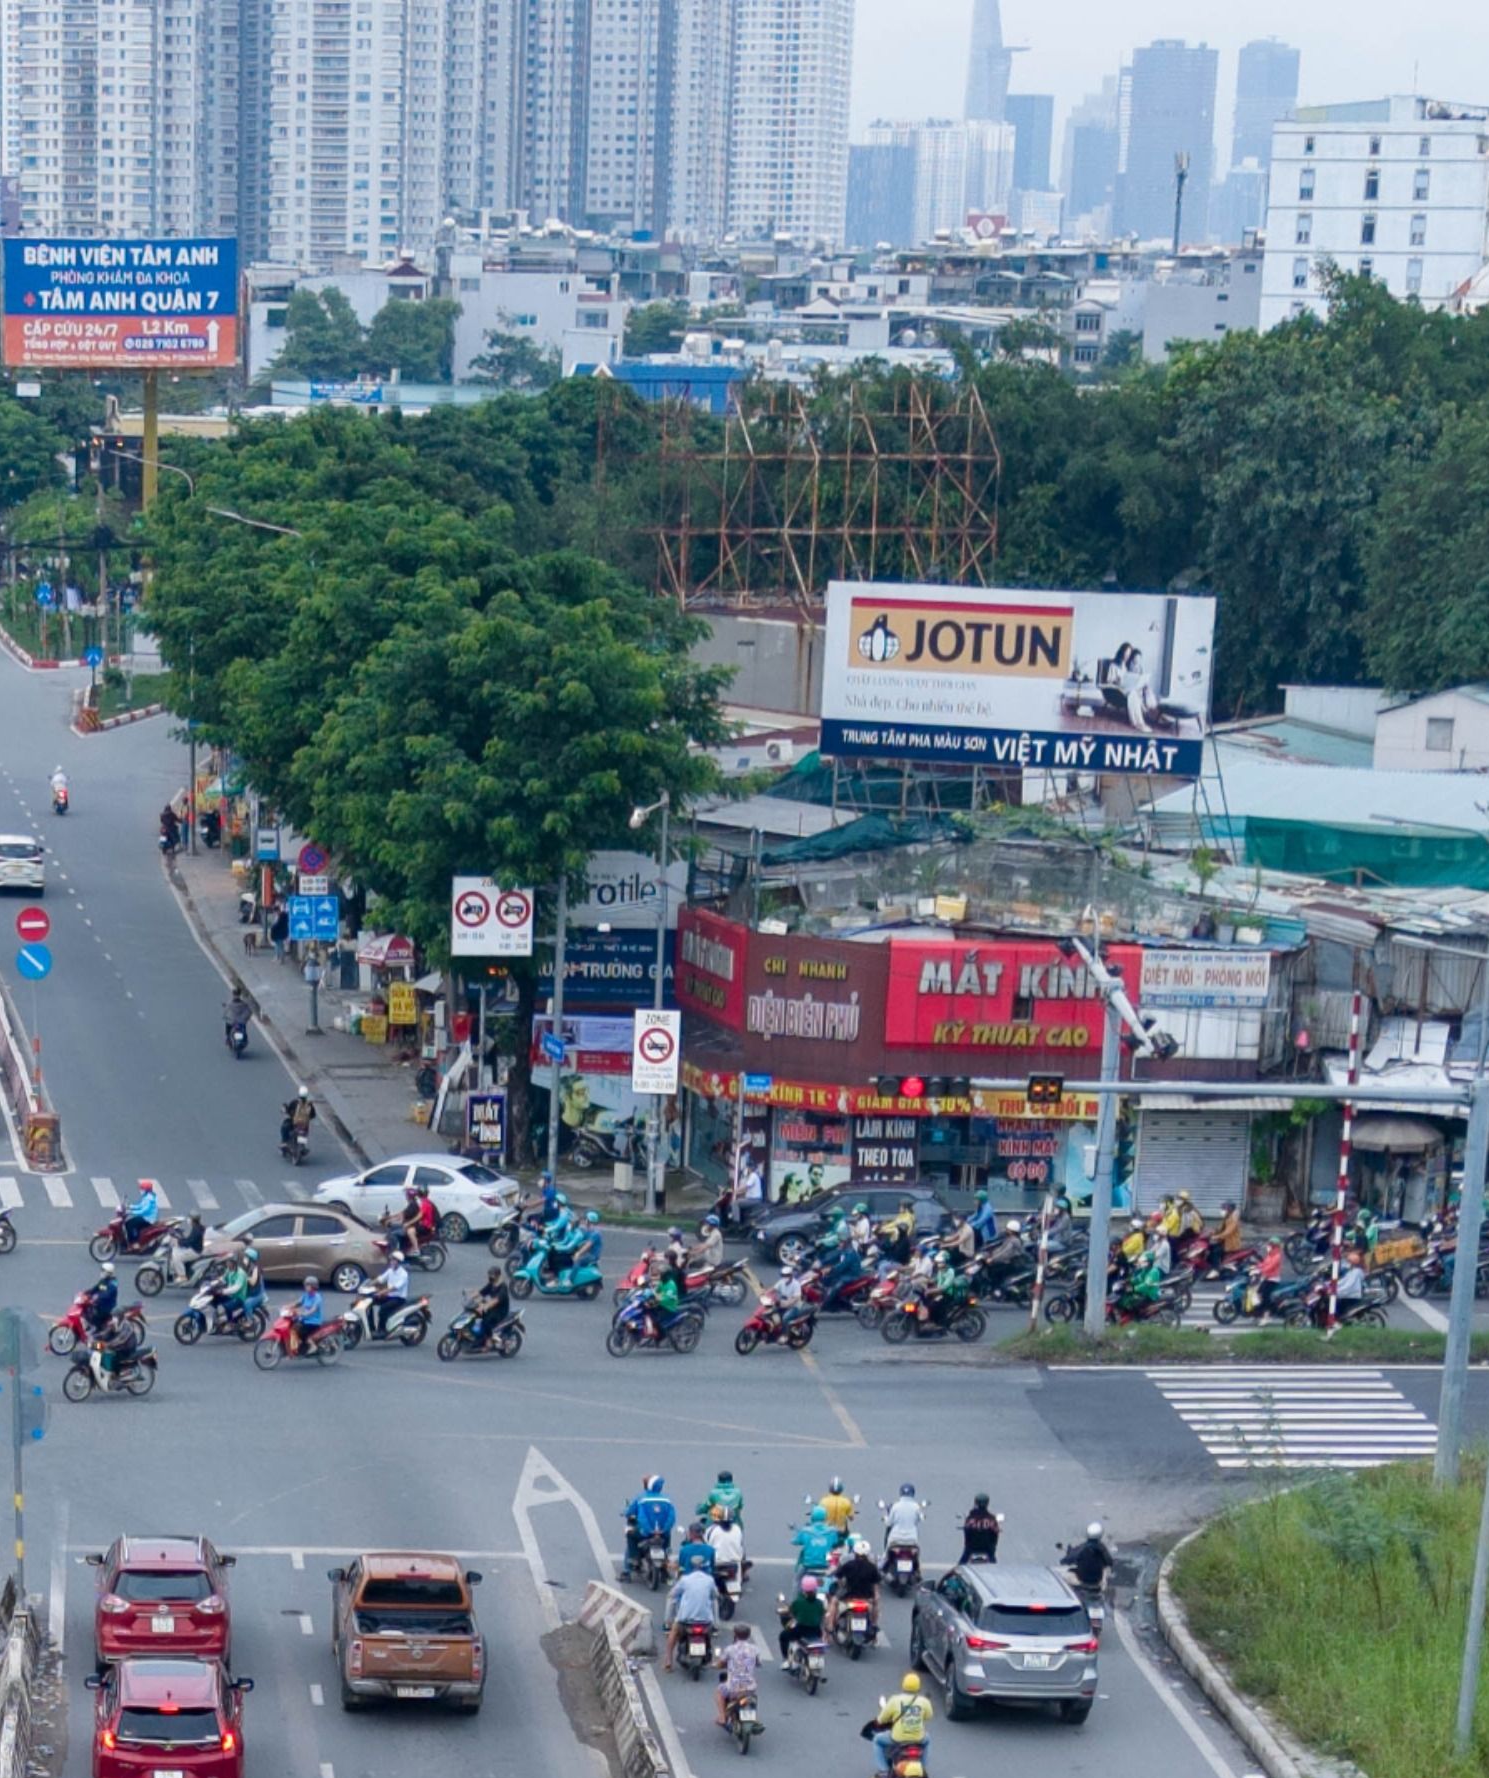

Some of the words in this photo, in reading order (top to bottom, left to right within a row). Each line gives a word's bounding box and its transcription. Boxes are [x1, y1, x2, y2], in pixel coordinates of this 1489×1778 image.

[24, 244, 76, 267] BỆNH
[80, 244, 125, 268] VIỆN
[130, 244, 171, 265] TÂM
[176, 246, 218, 265] ANH
[51, 268, 94, 284] PHÒNG
[97, 269, 133, 284] KHÁM
[155, 271, 190, 285] KHOA
[39, 287, 84, 310] TÂM
[90, 291, 136, 310] ANH
[141, 291, 201, 312] QUẬN
[207, 291, 219, 310] 7
[23, 319, 50, 336] CẤP
[53, 321, 83, 336] CỨU
[85, 323, 118, 337] 24/7
[164, 320, 189, 334] Km
[905, 619, 1062, 668] JOTUN
[841, 728, 878, 745] TRUNG
[881, 726, 905, 747] TÂM
[908, 732, 930, 748] PHA
[933, 729, 960, 750] MÀU
[993, 732, 1046, 764] VIỆT
[1054, 735, 1096, 765] MỸ
[1104, 740, 1178, 775] NHẬT
[764, 958, 786, 975] CHI
[798, 959, 847, 980] NHANH
[918, 947, 1003, 996] MẮT
[1019, 956, 1109, 1000] KÍNH
[933, 1022, 965, 1046] KỸ
[971, 1023, 1042, 1048] THUẬT
[1045, 1027, 1089, 1048] CAO
[858, 1148, 888, 1168] THEO
